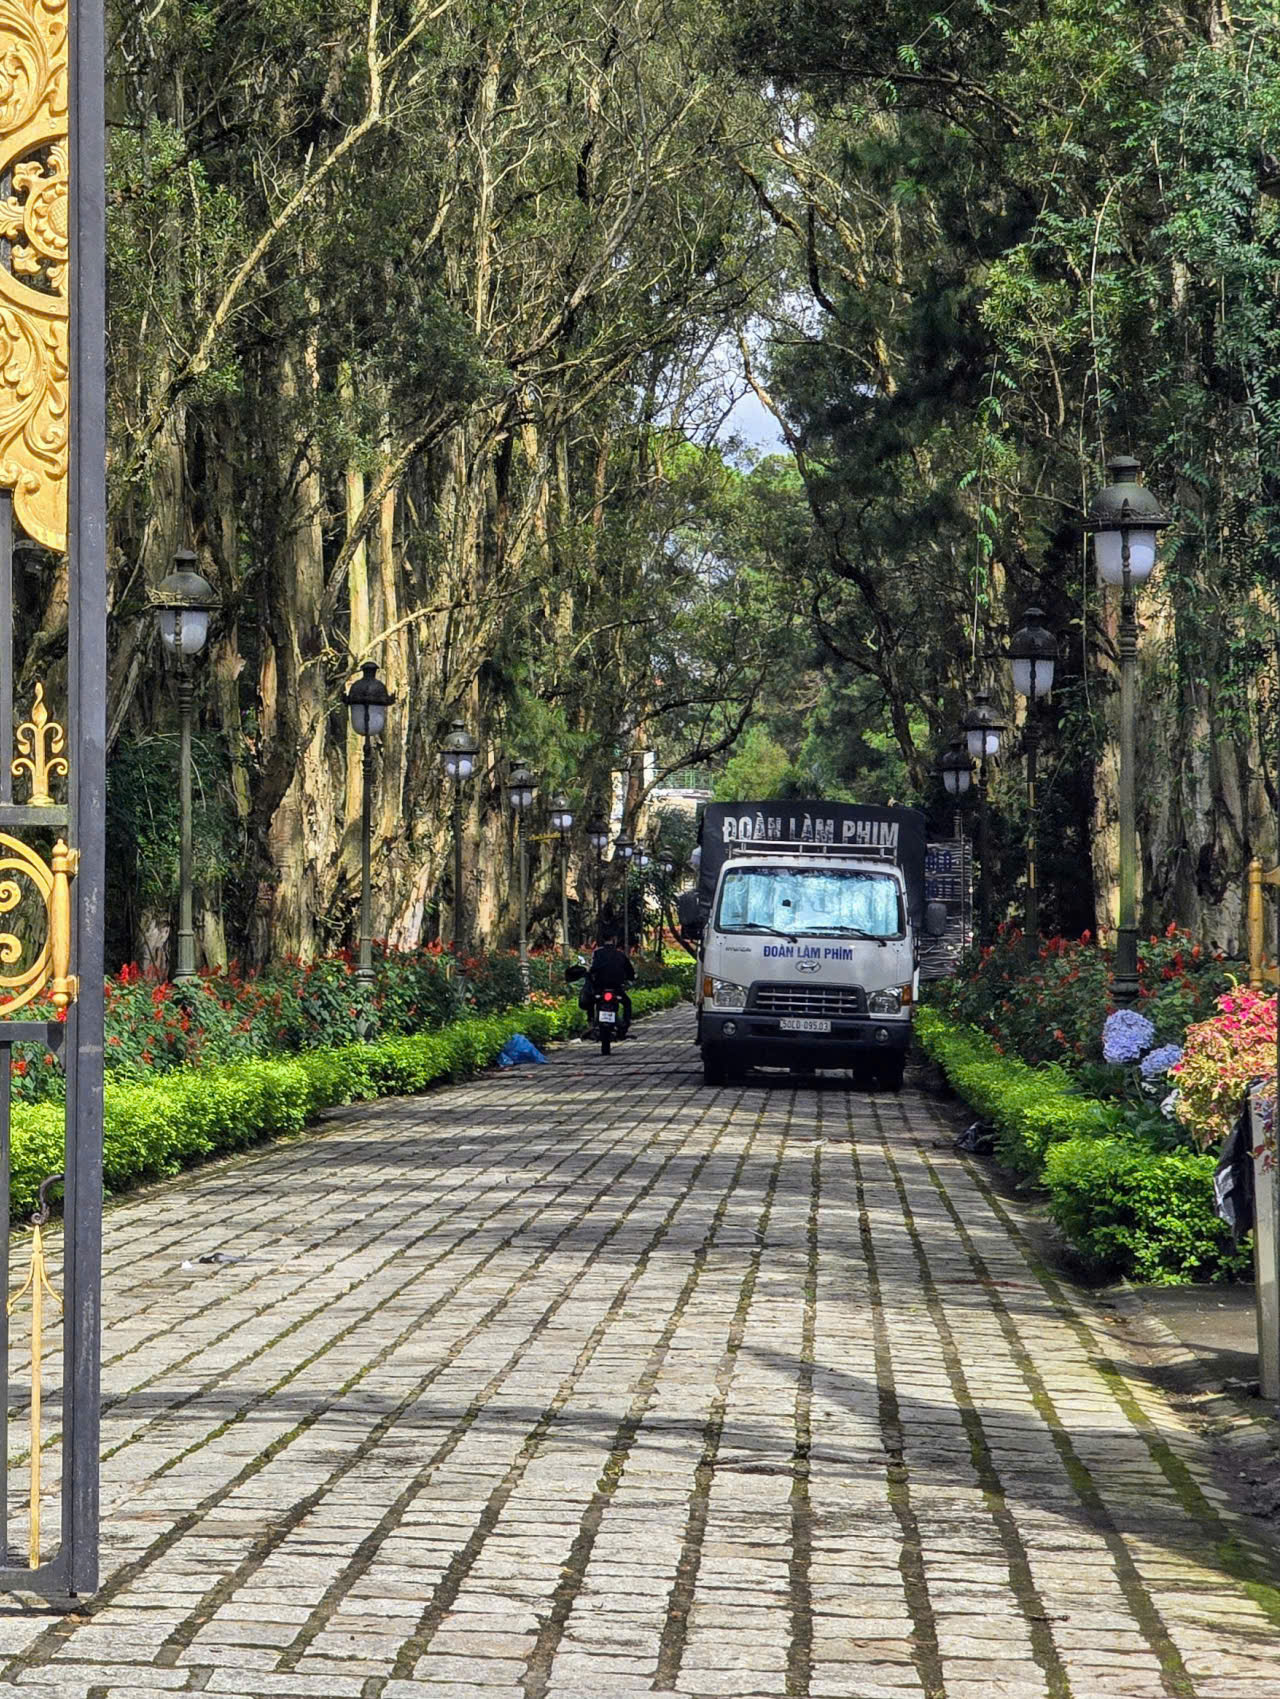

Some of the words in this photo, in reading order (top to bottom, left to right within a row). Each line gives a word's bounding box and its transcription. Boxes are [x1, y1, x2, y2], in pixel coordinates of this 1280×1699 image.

[722, 811, 782, 843] ĐOÀN
[789, 813, 834, 844] LÀM
[842, 819, 899, 847] PHIM
[763, 945, 794, 958] ĐOÀN
[797, 945, 821, 959] LÀM
